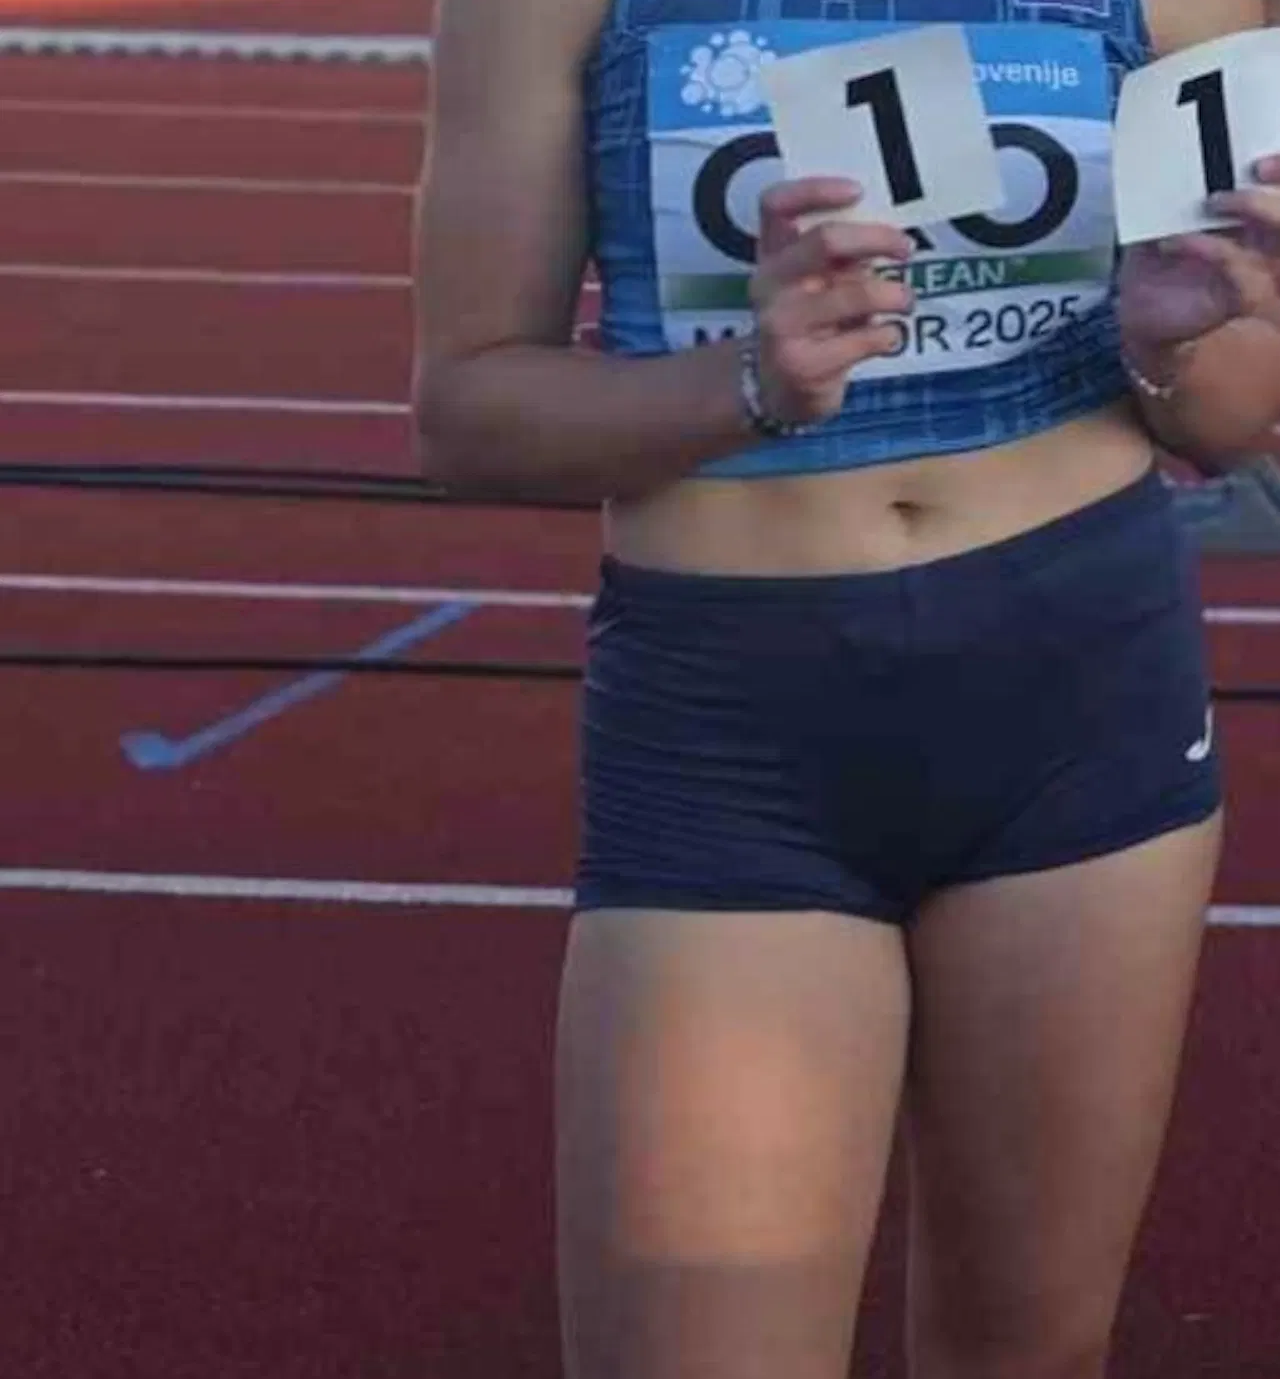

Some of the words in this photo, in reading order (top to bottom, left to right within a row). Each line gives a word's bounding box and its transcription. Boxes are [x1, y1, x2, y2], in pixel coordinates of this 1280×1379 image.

[692, 120, 1081, 266] CO
[846, 66, 927, 207] 1
[1175, 68, 1236, 194] 1
